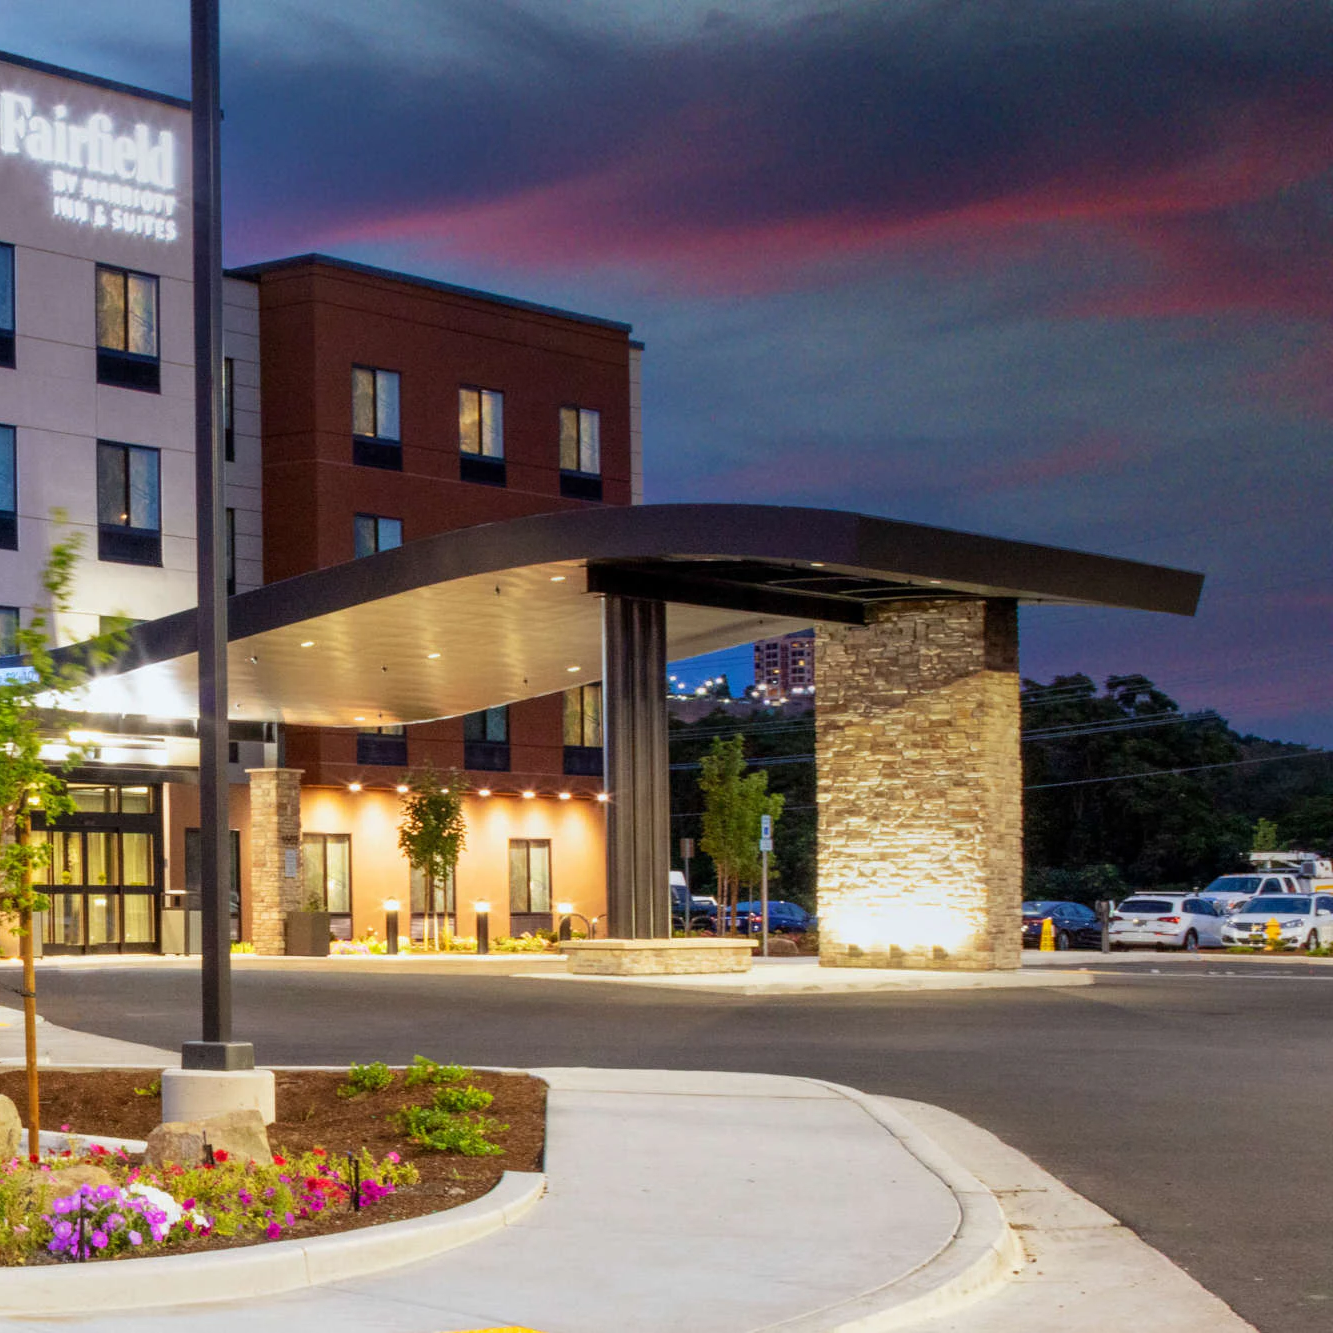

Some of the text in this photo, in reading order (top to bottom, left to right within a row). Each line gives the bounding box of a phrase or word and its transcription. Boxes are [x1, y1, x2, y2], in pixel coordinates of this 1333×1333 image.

[0, 91, 175, 189] Fairfield
[52, 170, 176, 216] BY MARRIOTT
[53, 196, 178, 240] INN & SUITES
